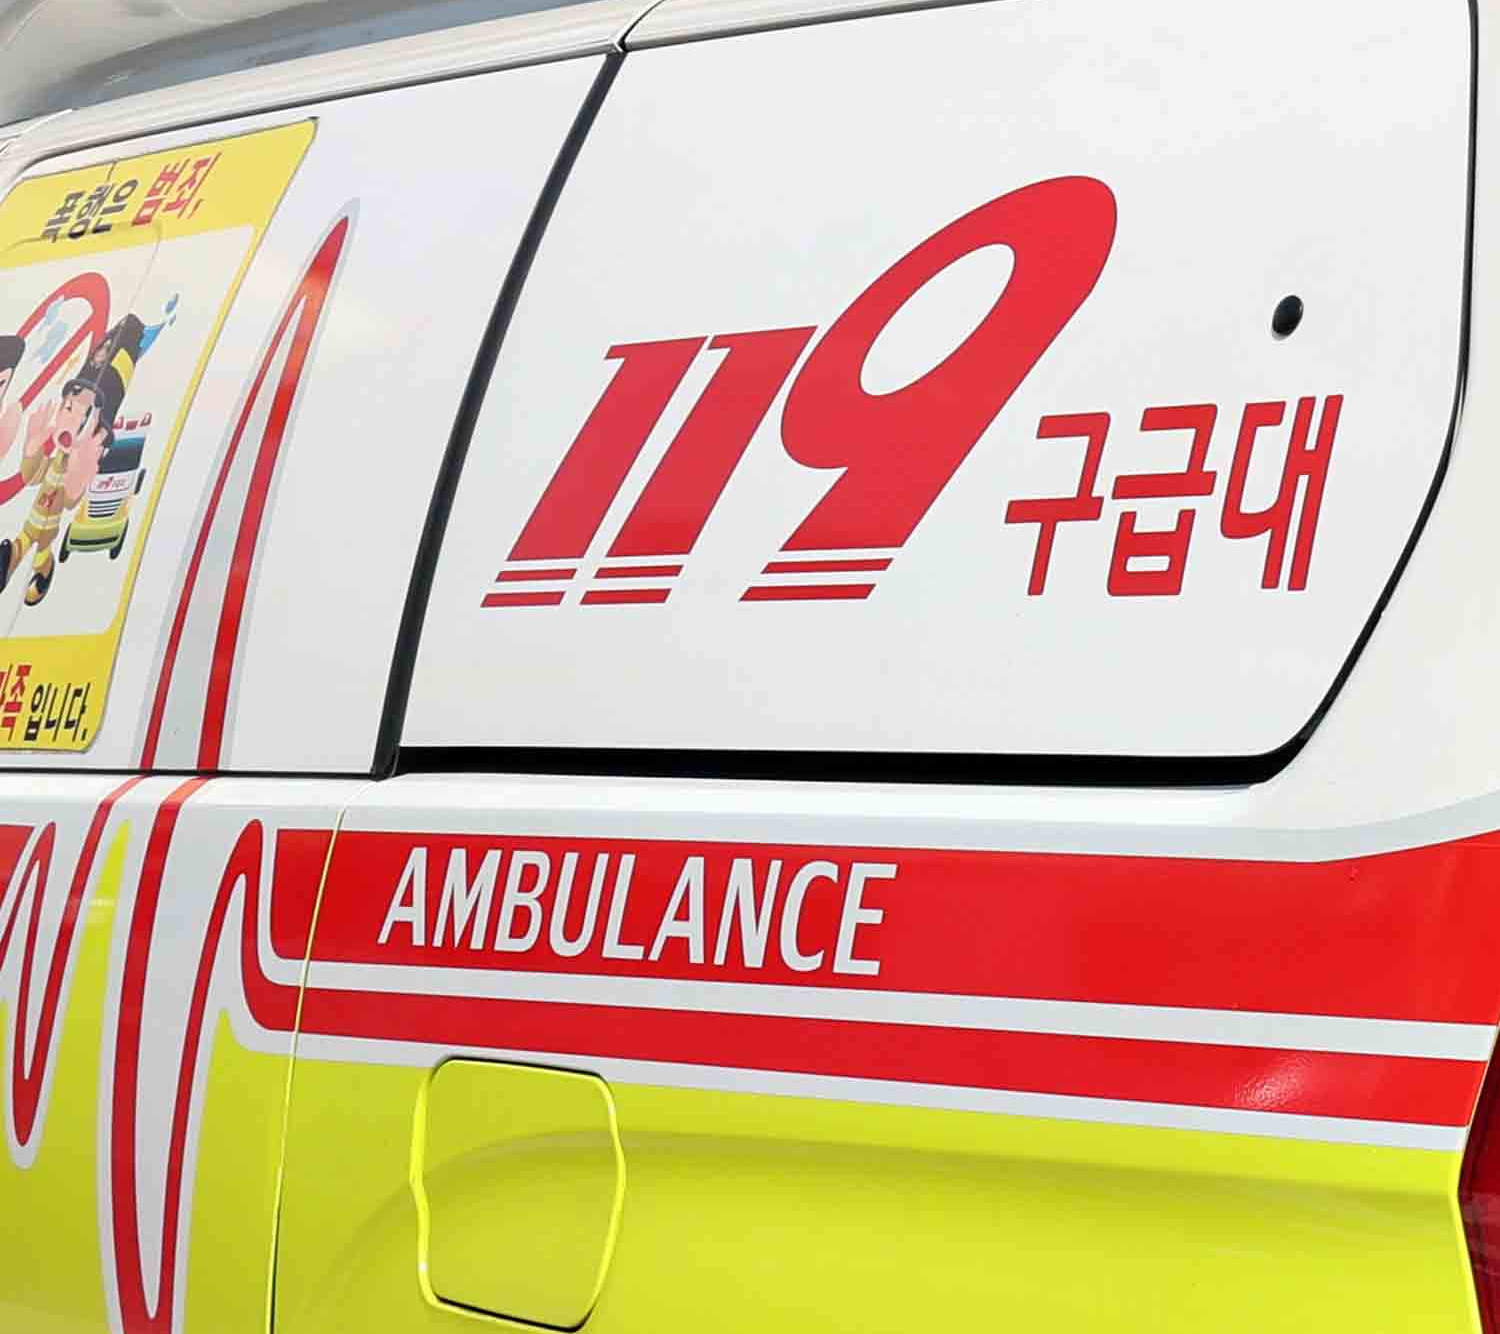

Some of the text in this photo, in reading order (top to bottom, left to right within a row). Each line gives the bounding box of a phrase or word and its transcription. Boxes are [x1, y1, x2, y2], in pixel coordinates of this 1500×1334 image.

[40, 179, 139, 243] 폭행은
[479, 175, 1342, 608] 119 구급대
[377, 846, 898, 977] AMBULANCE
